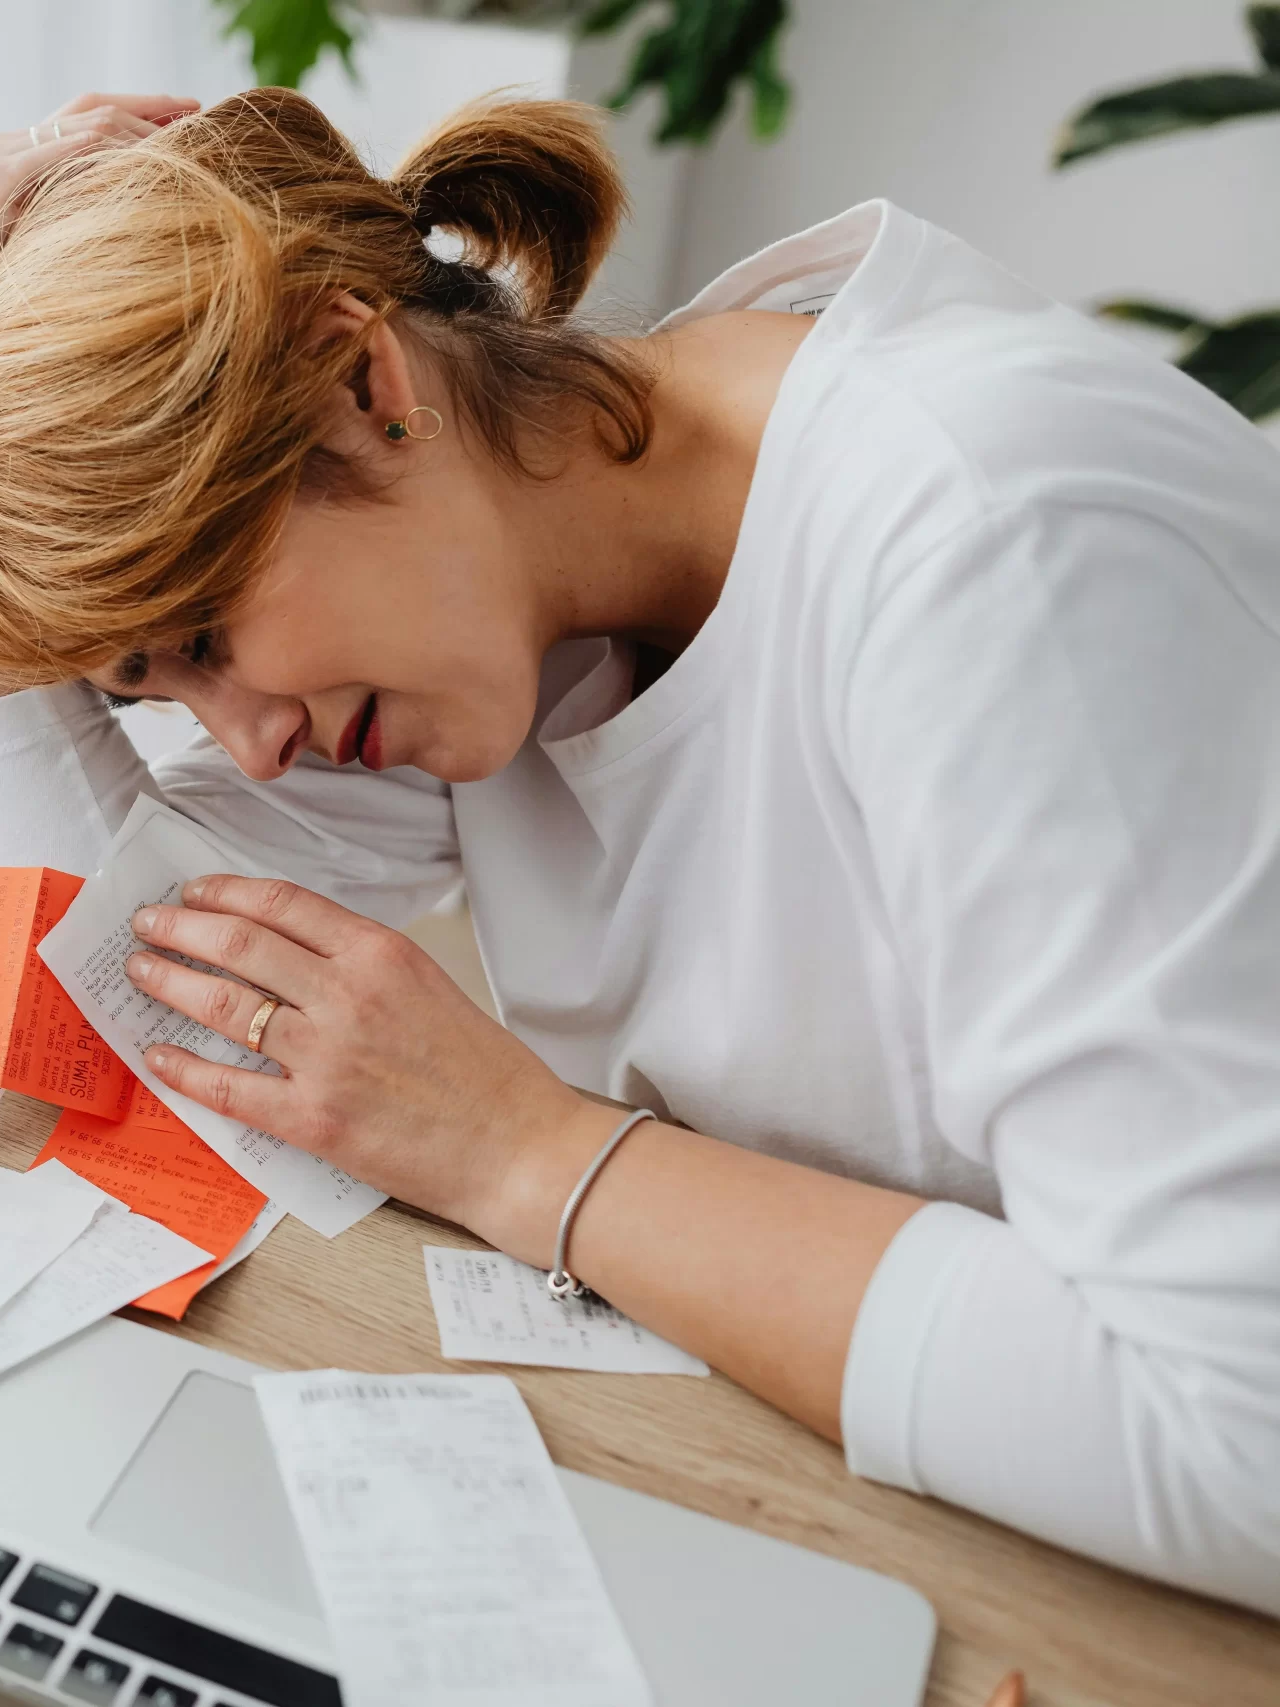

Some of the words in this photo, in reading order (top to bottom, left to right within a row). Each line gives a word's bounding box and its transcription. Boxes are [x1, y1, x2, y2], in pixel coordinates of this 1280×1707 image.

[68, 1058, 90, 1099] SUMA
[134, 1103, 145, 1116] Nr
[157, 1108, 169, 1120] Nr
